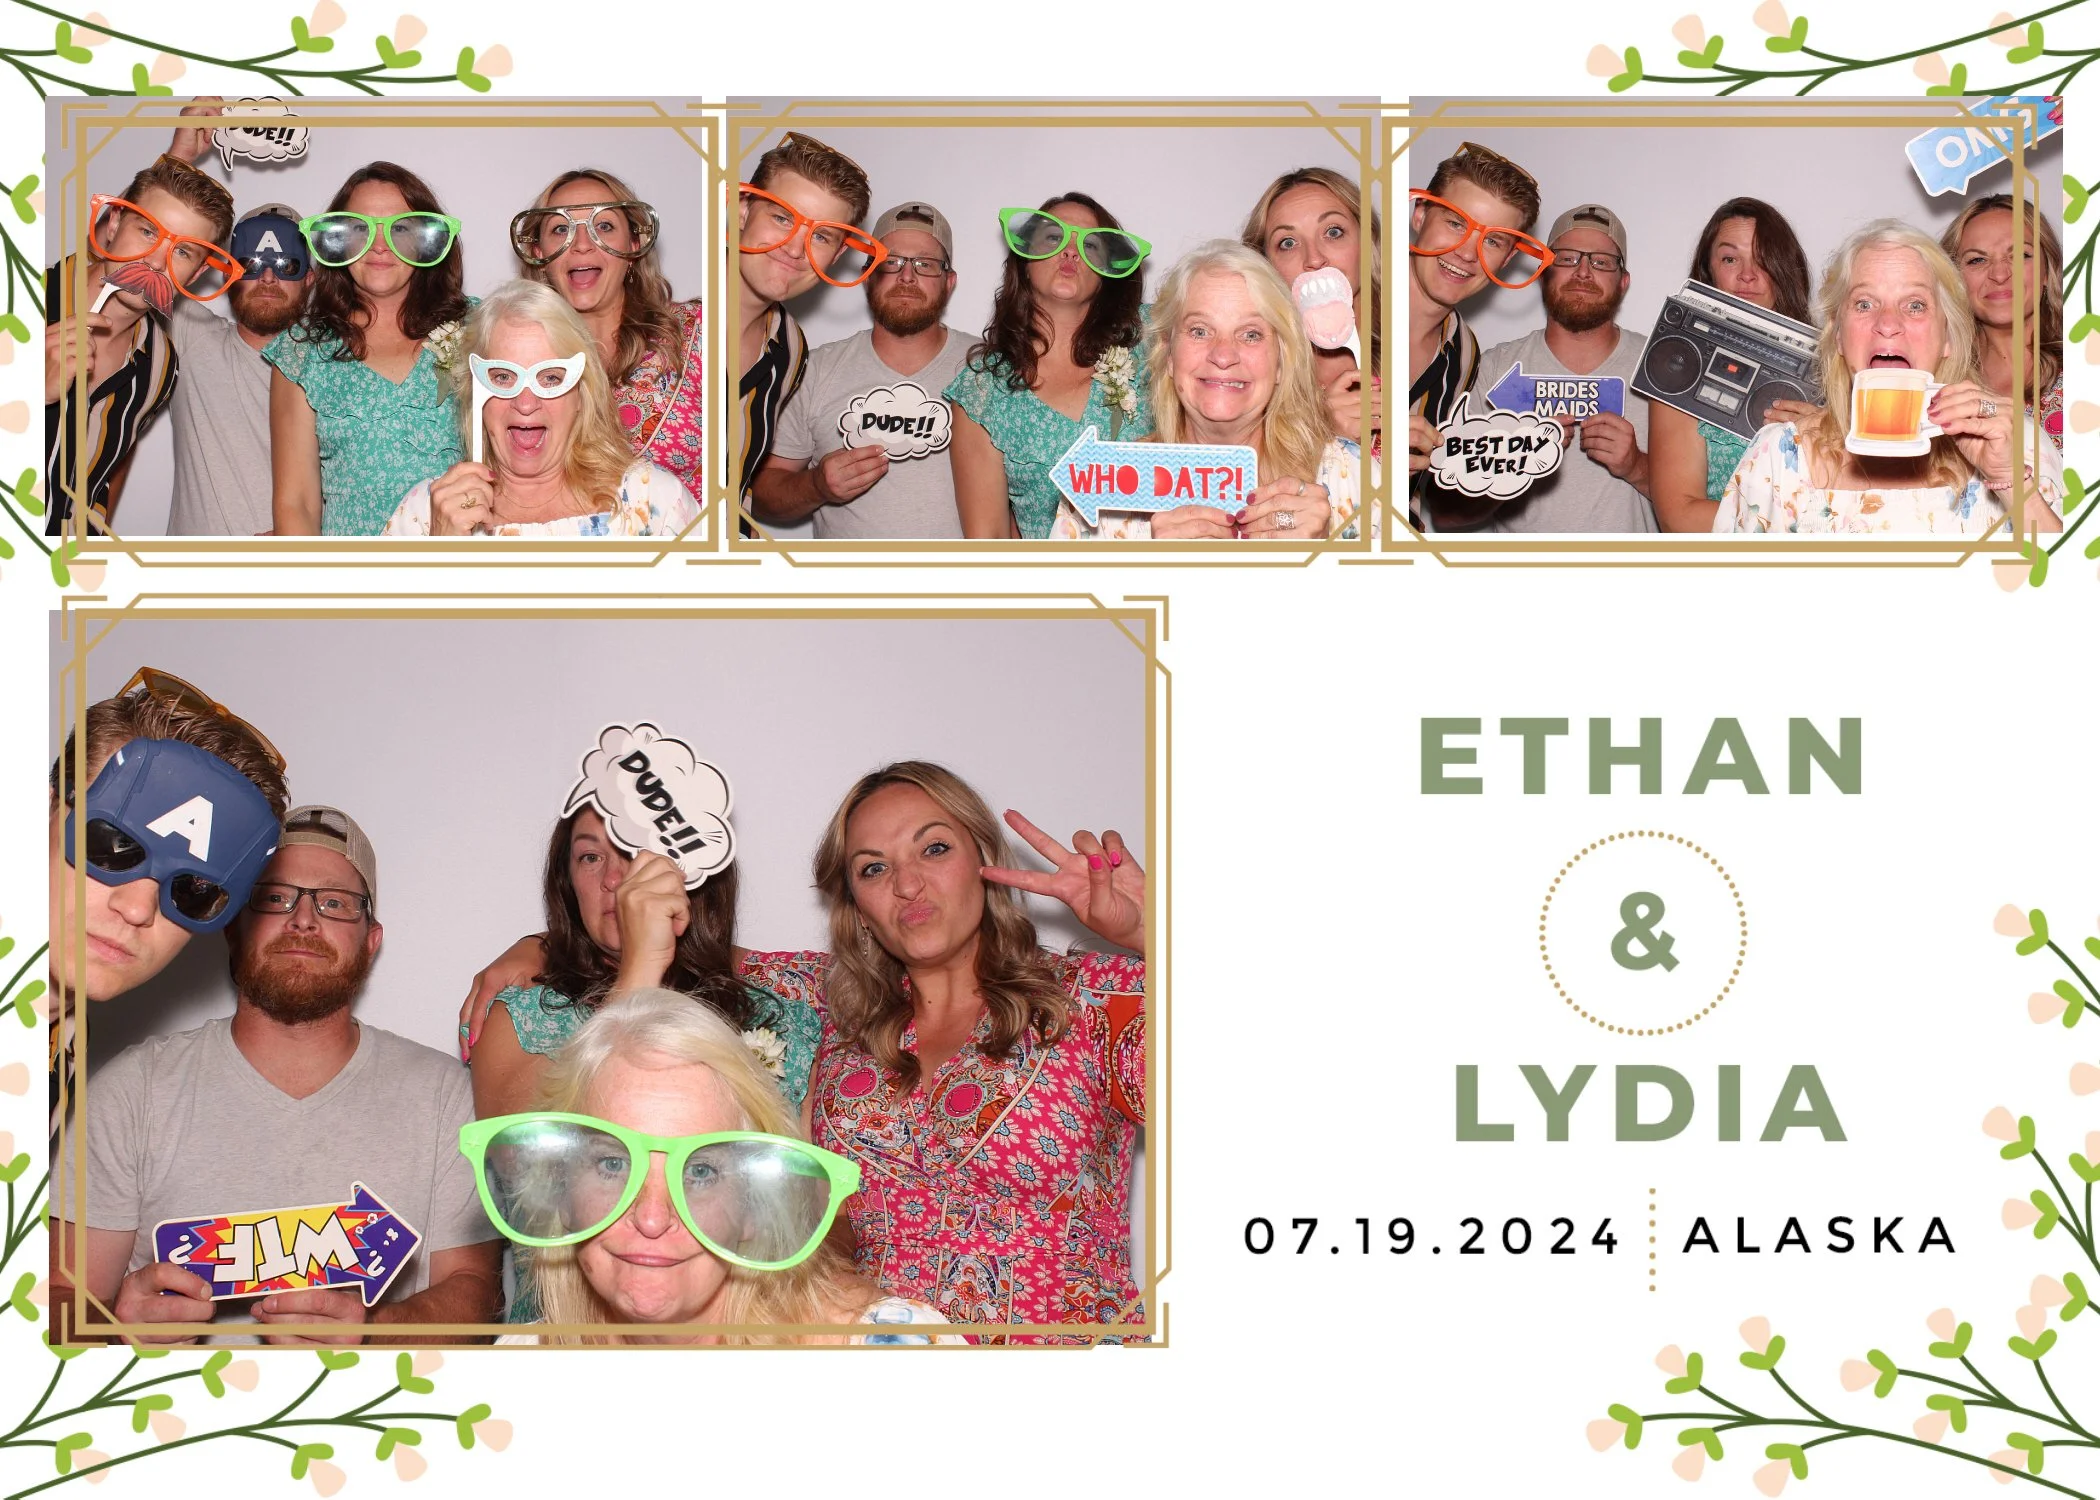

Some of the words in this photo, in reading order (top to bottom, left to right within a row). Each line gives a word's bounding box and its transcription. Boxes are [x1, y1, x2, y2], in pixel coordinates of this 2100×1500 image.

[255, 230, 283, 253] A
[1535, 381, 1600, 399] BRIDES
[1534, 400, 1600, 417] MAIDS
[862, 412, 936, 439] DUDE!!
[1446, 435, 1504, 457] BEST
[1508, 436, 1550, 454] DAY
[1465, 455, 1528, 475] EVER!
[1068, 463, 1139, 495] WHO
[1153, 465, 1243, 501] DAT?!
[618, 750, 707, 860] DUDE!!
[145, 795, 214, 863] A
[213, 1211, 360, 1283] WTF
